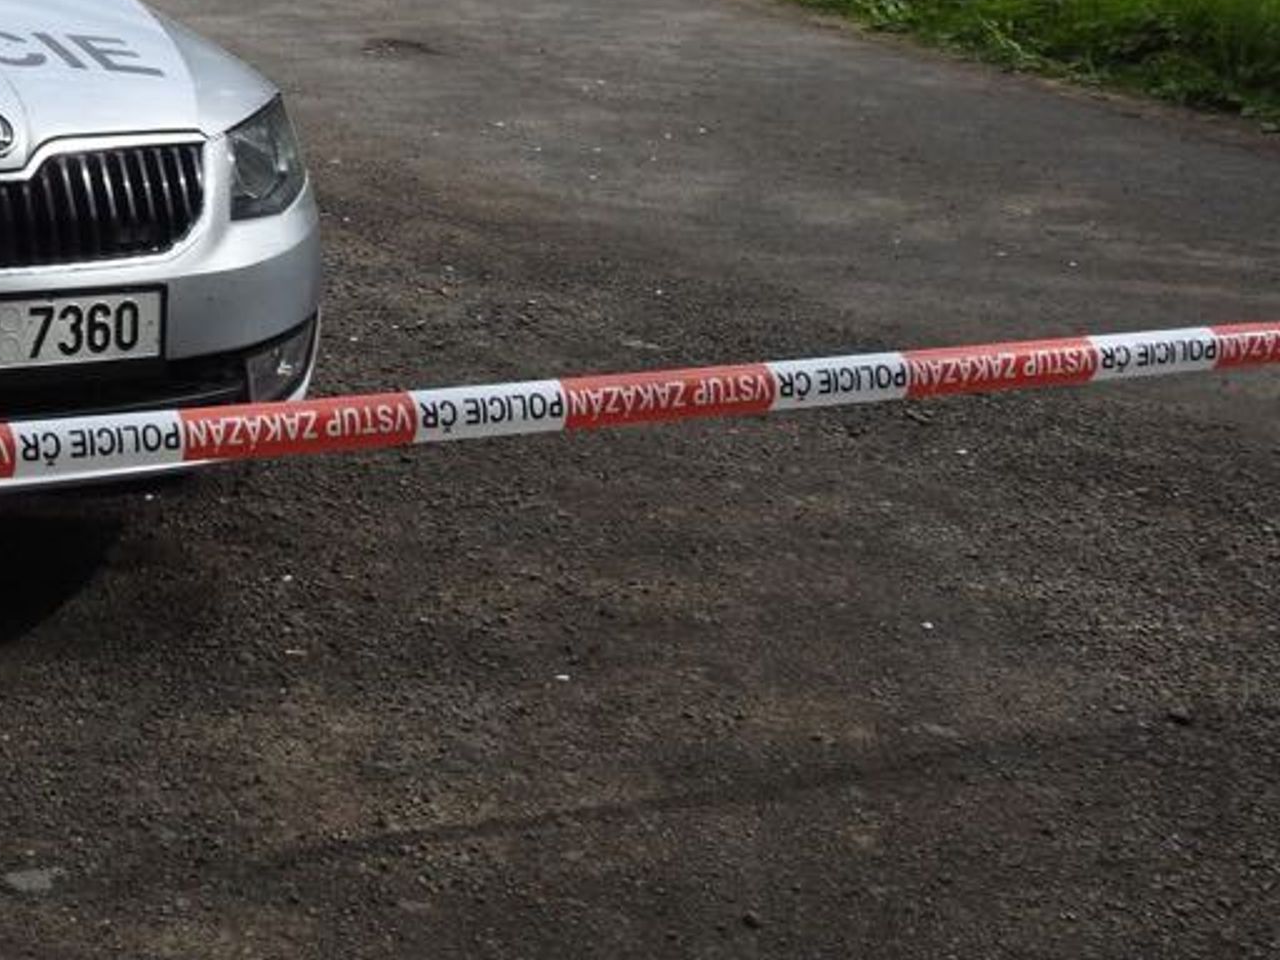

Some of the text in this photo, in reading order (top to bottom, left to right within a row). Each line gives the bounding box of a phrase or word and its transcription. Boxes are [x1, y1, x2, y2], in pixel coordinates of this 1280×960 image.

[28, 299, 140, 360] 7360
[911, 347, 1094, 390] VSTUP ZAKÁZÁN
[1101, 338, 1217, 373] POLICIE ČR
[569, 374, 771, 420] VSTUP ZAKÁZÁN
[779, 363, 907, 401] POLICIE ČR
[187, 405, 413, 452] VSTUP ZAKÁZÁN
[421, 391, 565, 433] POLICIE ČR
[21, 422, 181, 468] POLICIE ČR
